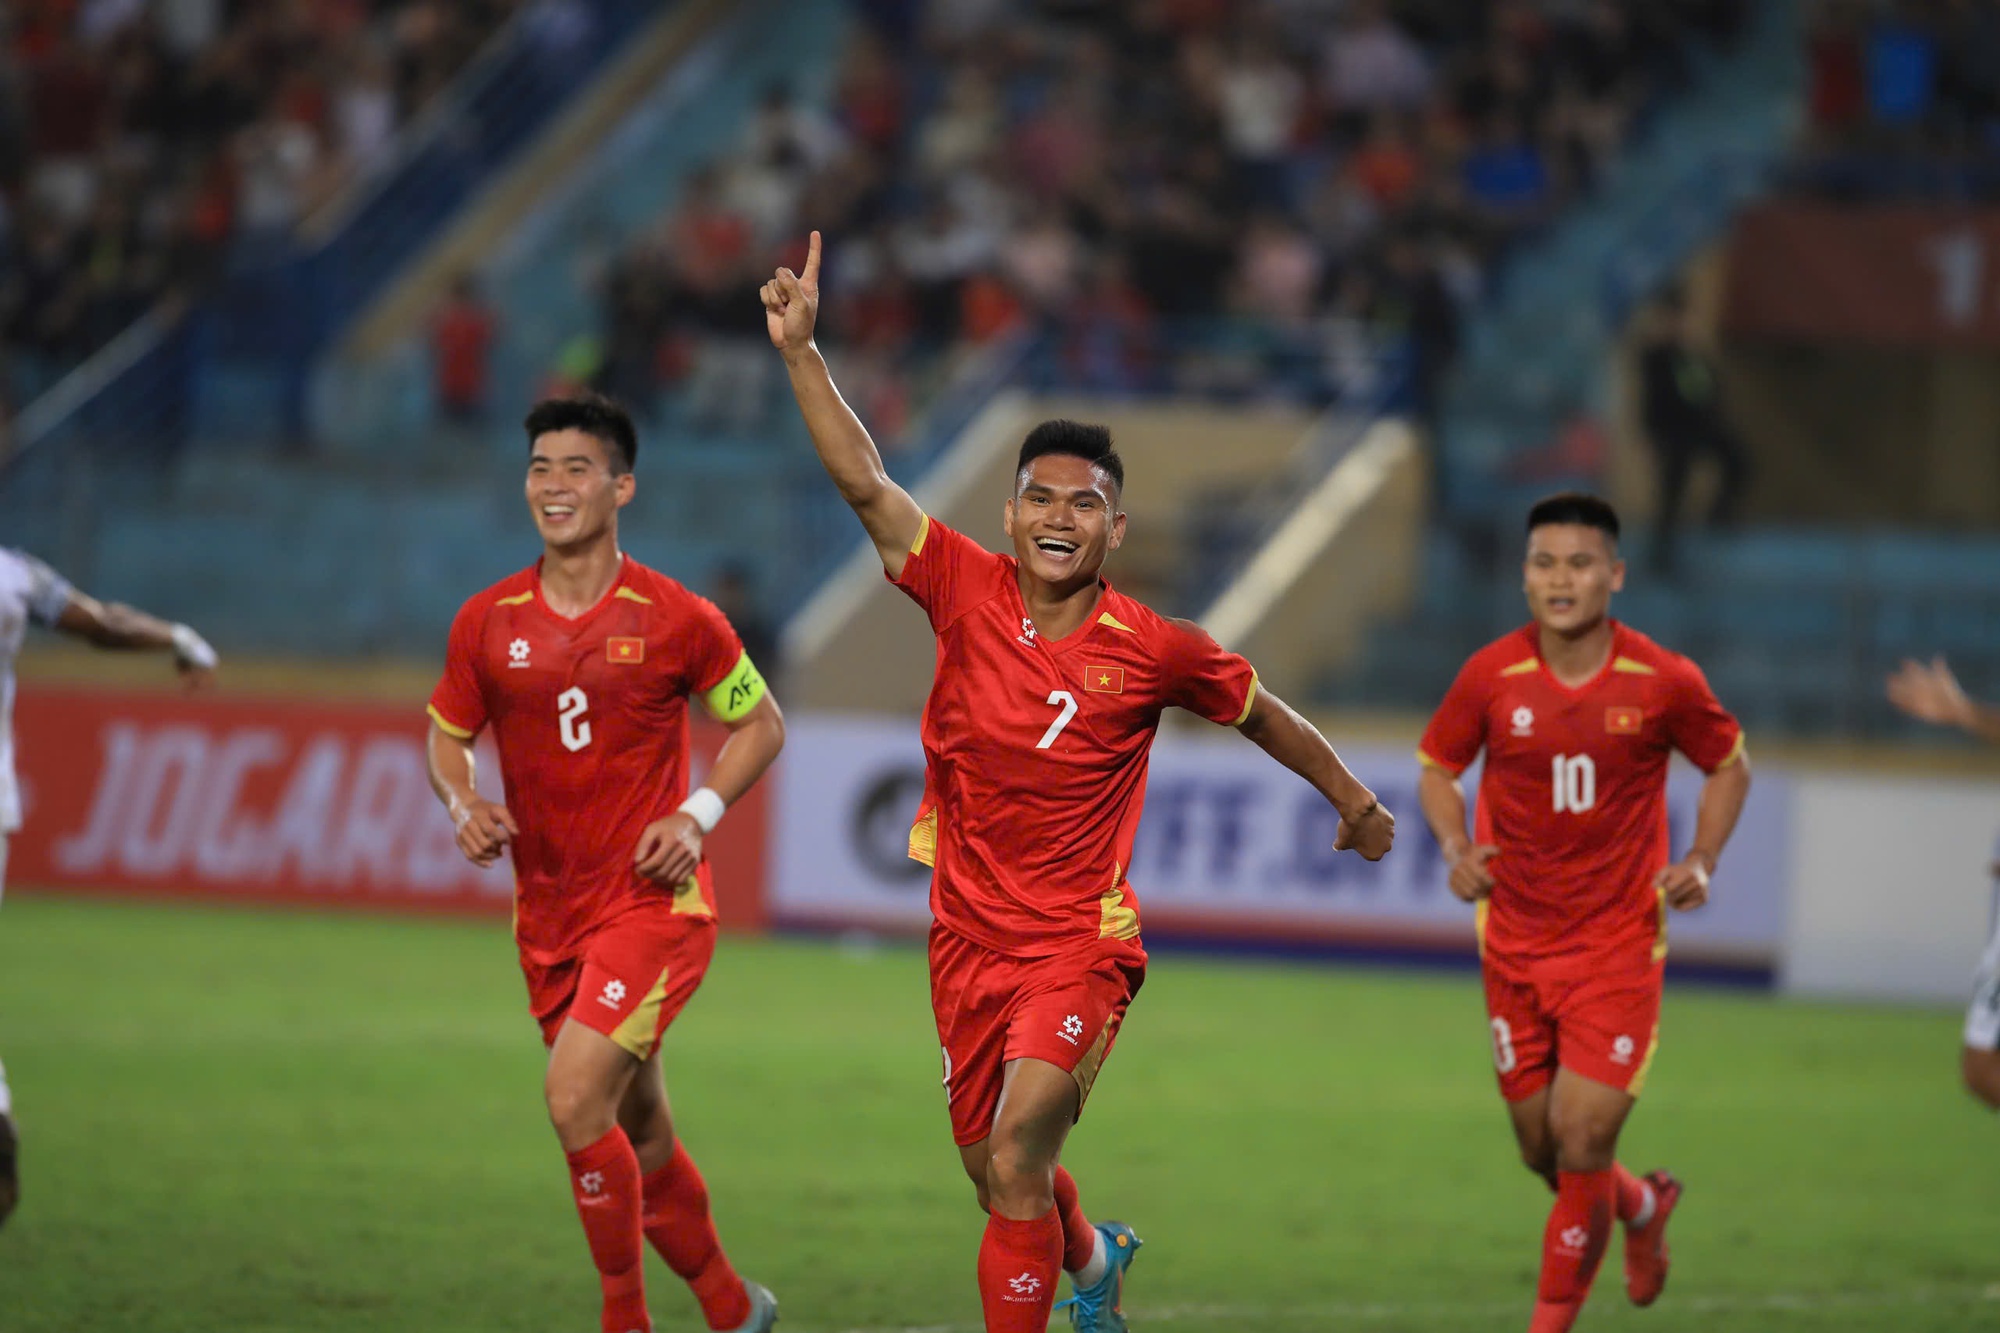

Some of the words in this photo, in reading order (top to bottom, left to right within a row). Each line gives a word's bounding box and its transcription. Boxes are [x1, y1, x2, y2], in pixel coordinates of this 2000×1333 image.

[558, 686, 592, 752] 2
[1035, 690, 1079, 749] 7
[1552, 752, 1596, 815] 10
